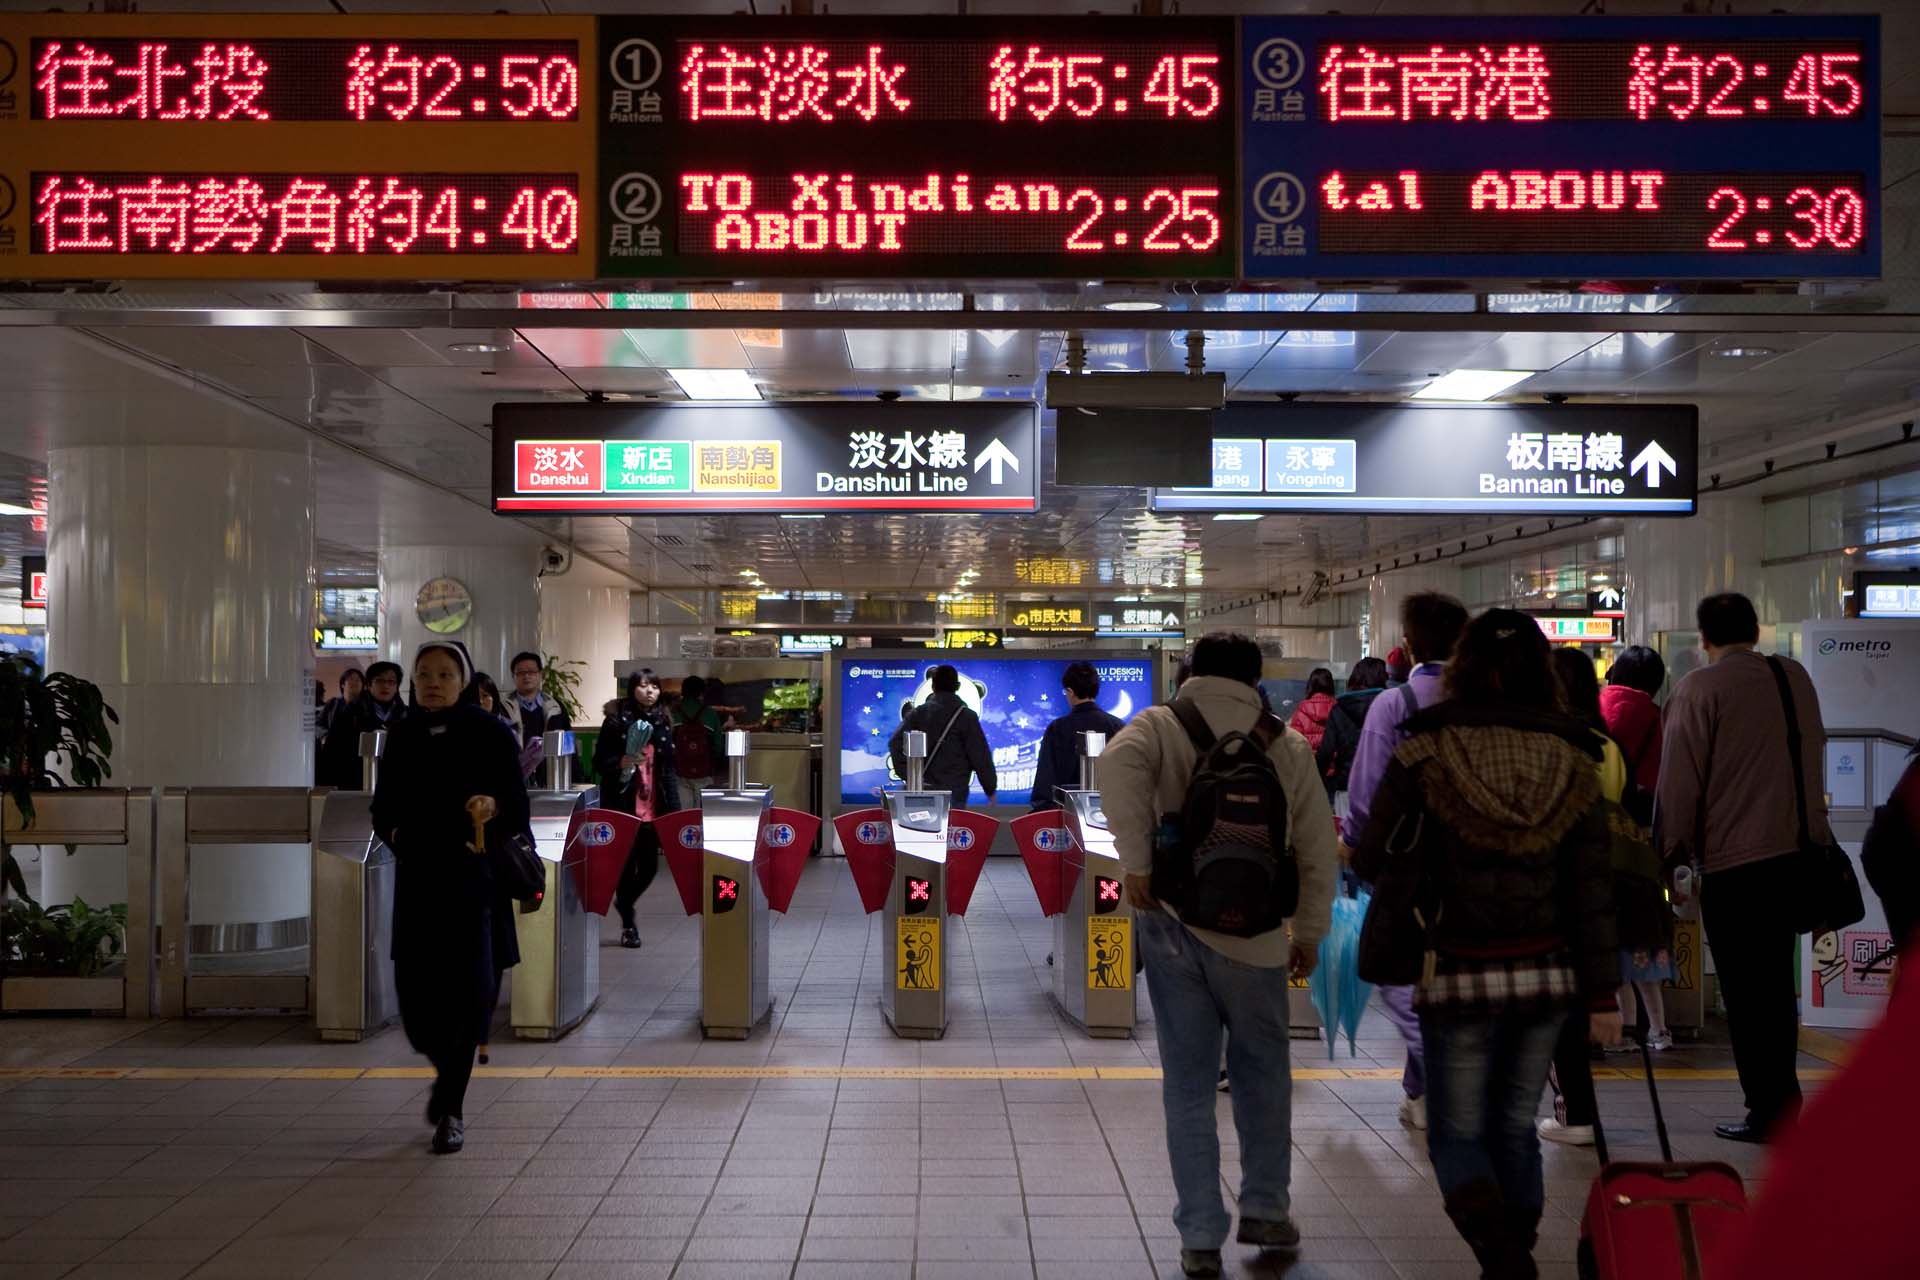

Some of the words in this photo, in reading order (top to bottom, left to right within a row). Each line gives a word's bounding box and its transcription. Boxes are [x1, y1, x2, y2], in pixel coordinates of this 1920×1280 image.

[37, 43, 270, 121] 往北投
[346, 45, 578, 121] 約2:50
[680, 45, 911, 121] 往淡水
[989, 45, 1220, 122] 約5:45
[1318, 45, 1551, 122] 往南港
[1628, 45, 1861, 120] 約2:45
[610, 89, 662, 113] 月台
[1253, 89, 1305, 112] 月台
[681, 173, 753, 212] TO
[1321, 170, 1423, 211] tal
[1470, 170, 1664, 211] ABOUT
[1065, 187, 1220, 251] 2:25
[1707, 187, 1863, 248] 2:30
[610, 223, 662, 247] 月台
[713, 211, 908, 252] ABOUT
[1254, 223, 1306, 246] 月台
[533, 447, 584, 471] 淡水
[622, 446, 673, 471] 新店
[700, 447, 775, 471] 南勢角
[849, 430, 967, 470] 淡水線
[1212, 446, 1242, 471] 港
[1285, 446, 1336, 471] 永寧
[1507, 432, 1625, 471] 板南線
[529, 472, 589, 486] Danshui
[620, 471, 675, 486] Xindian
[700, 472, 776, 488] Nanshijiao
[816, 472, 912, 492] Danshui
[918, 472, 968, 492] Line
[1212, 472, 1250, 488] gang
[1276, 472, 1345, 488] Yongning
[1480, 473, 1568, 495] Bannan
[1575, 473, 1625, 495] Line
[1029, 609, 1082, 624] 市民大道
[1839, 640, 1891, 651] metro
[1109, 667, 1144, 676] DESIGN
